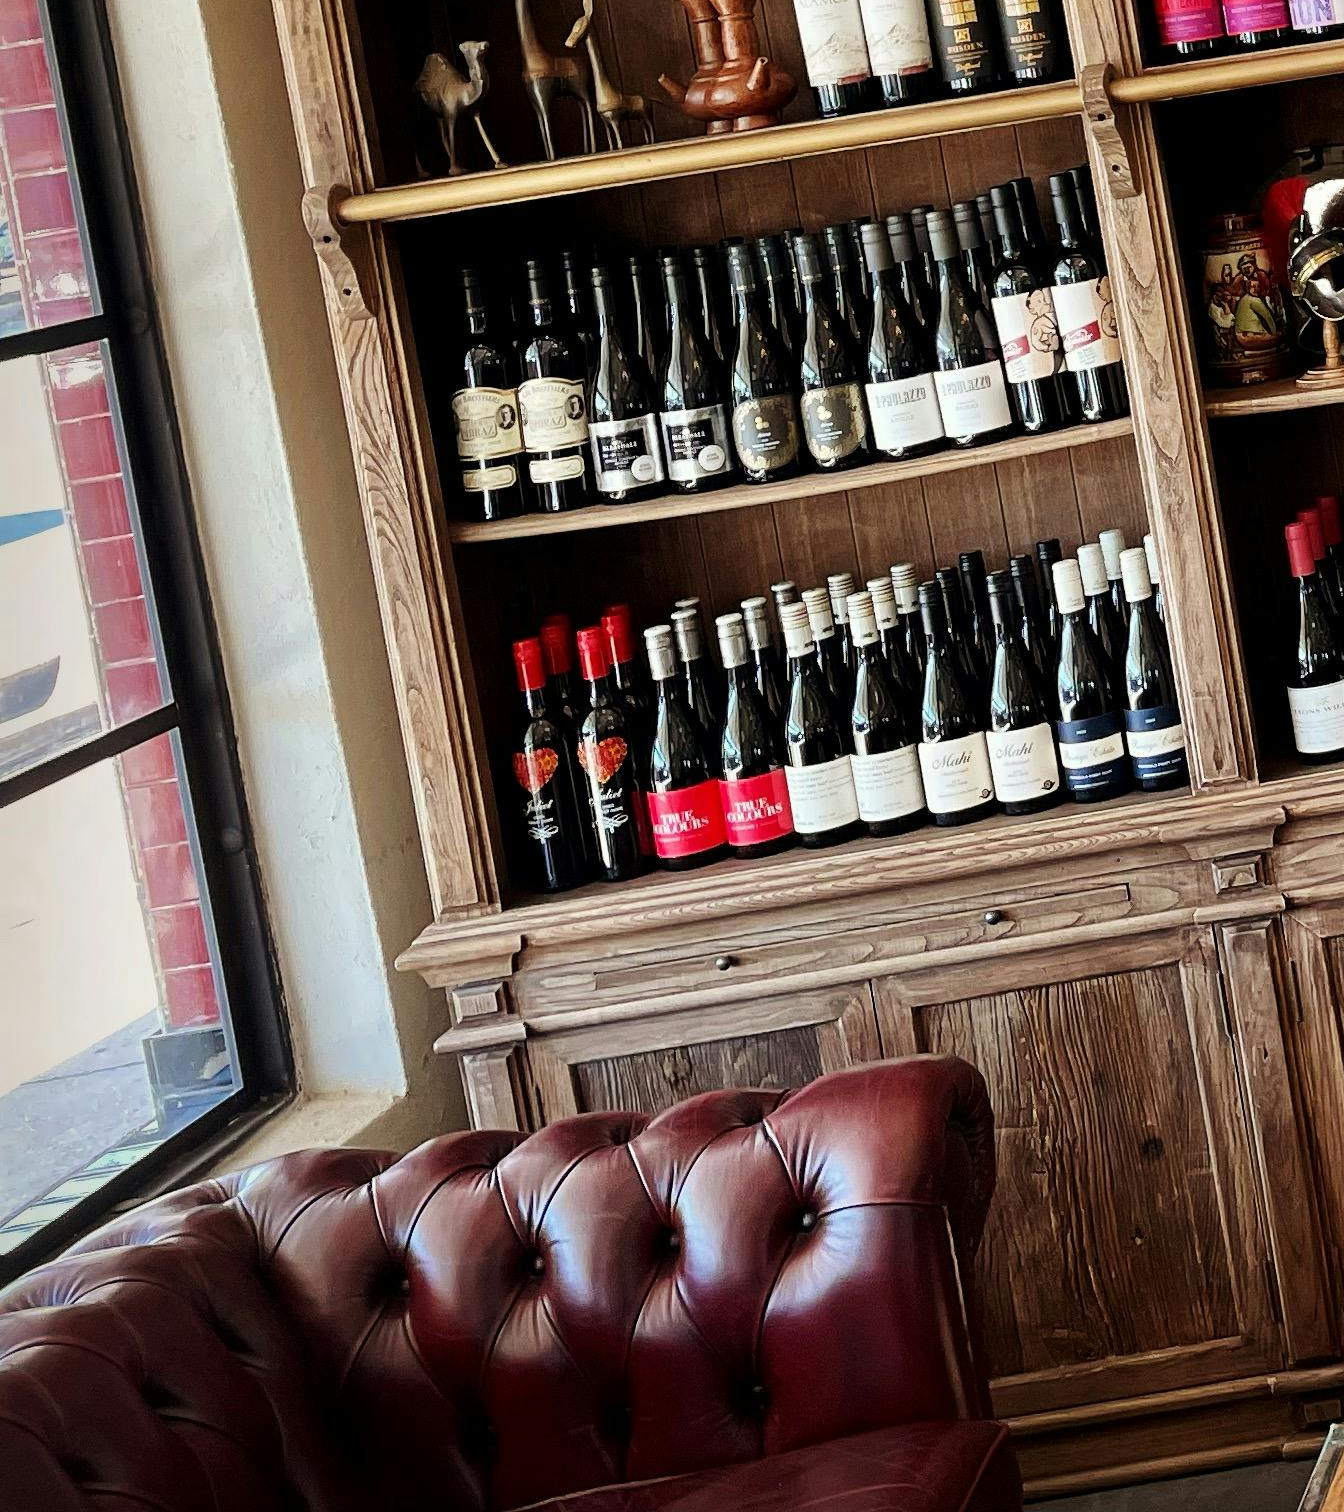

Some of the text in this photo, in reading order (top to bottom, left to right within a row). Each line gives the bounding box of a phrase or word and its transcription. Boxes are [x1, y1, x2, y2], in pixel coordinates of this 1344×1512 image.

[995, 742, 1034, 759] Mahi
[931, 750, 973, 770] Mahi
[734, 796, 768, 812] TRUE
[660, 809, 694, 826] TRUE
[727, 803, 783, 823] COLOURS
[653, 817, 709, 835] COLOURS
